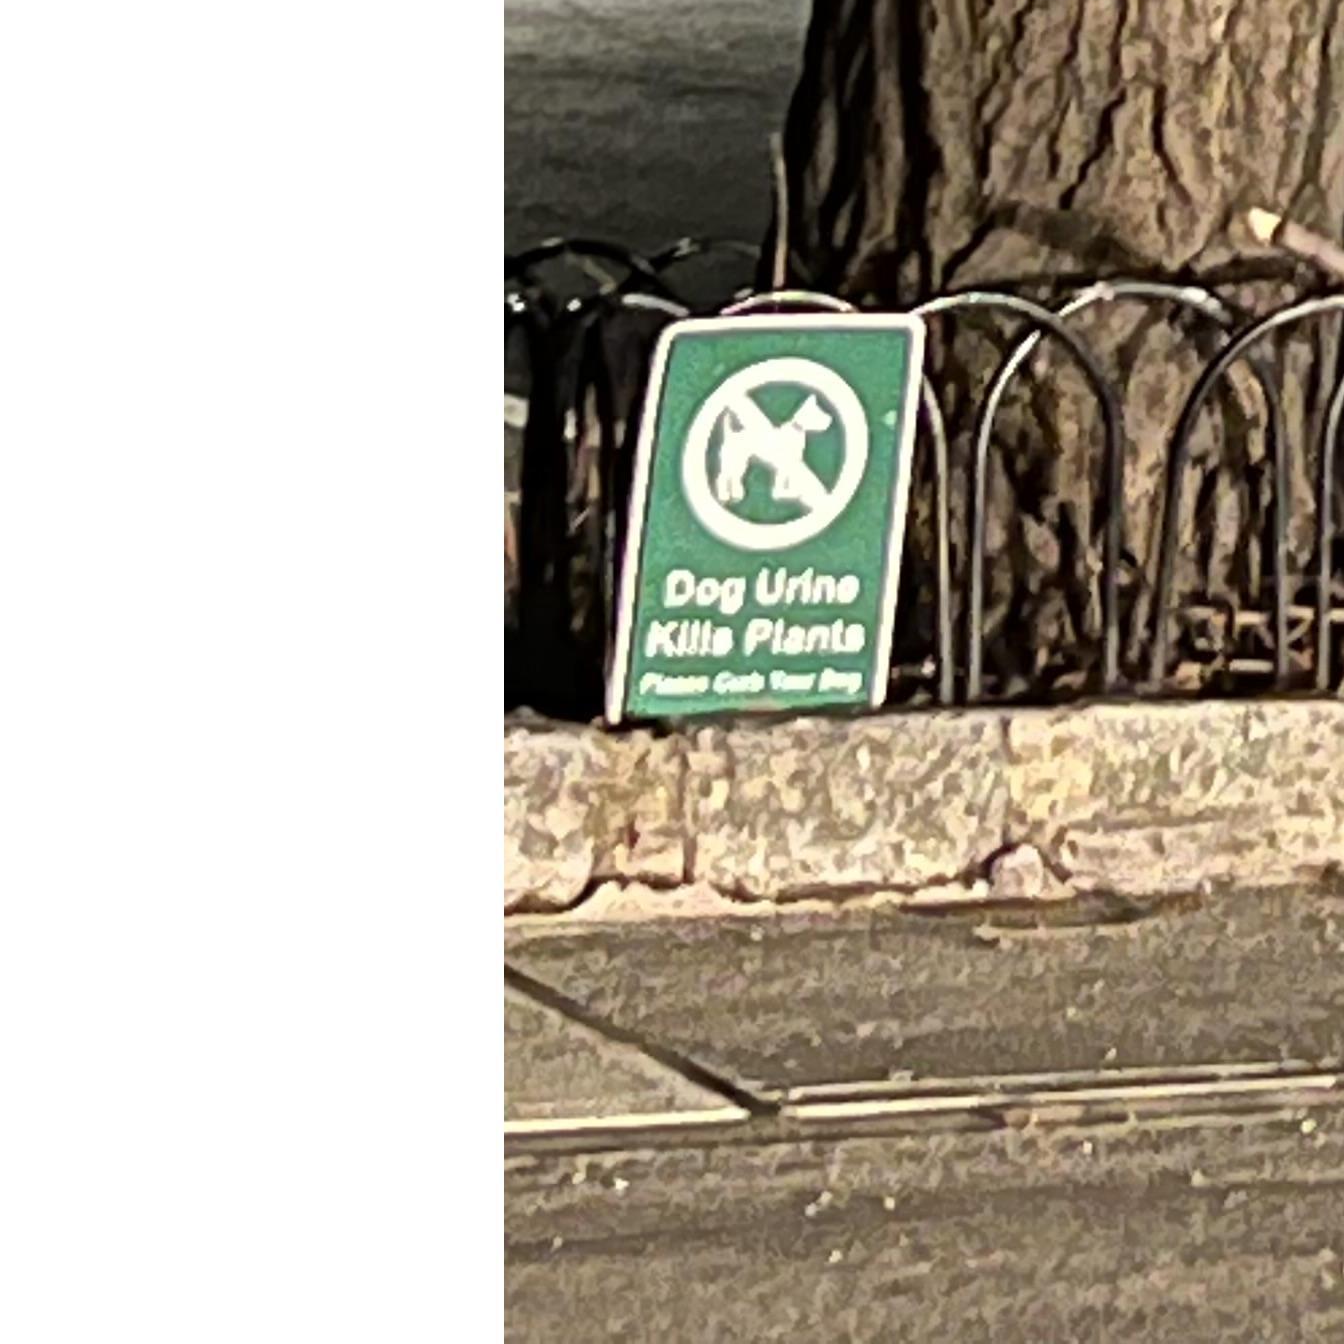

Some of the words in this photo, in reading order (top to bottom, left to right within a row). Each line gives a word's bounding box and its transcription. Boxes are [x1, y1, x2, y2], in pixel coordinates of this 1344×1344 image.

[663, 569, 747, 616] Dog
[754, 567, 860, 607] Urine
[644, 619, 734, 658] Kills
[743, 618, 865, 656] Plants
